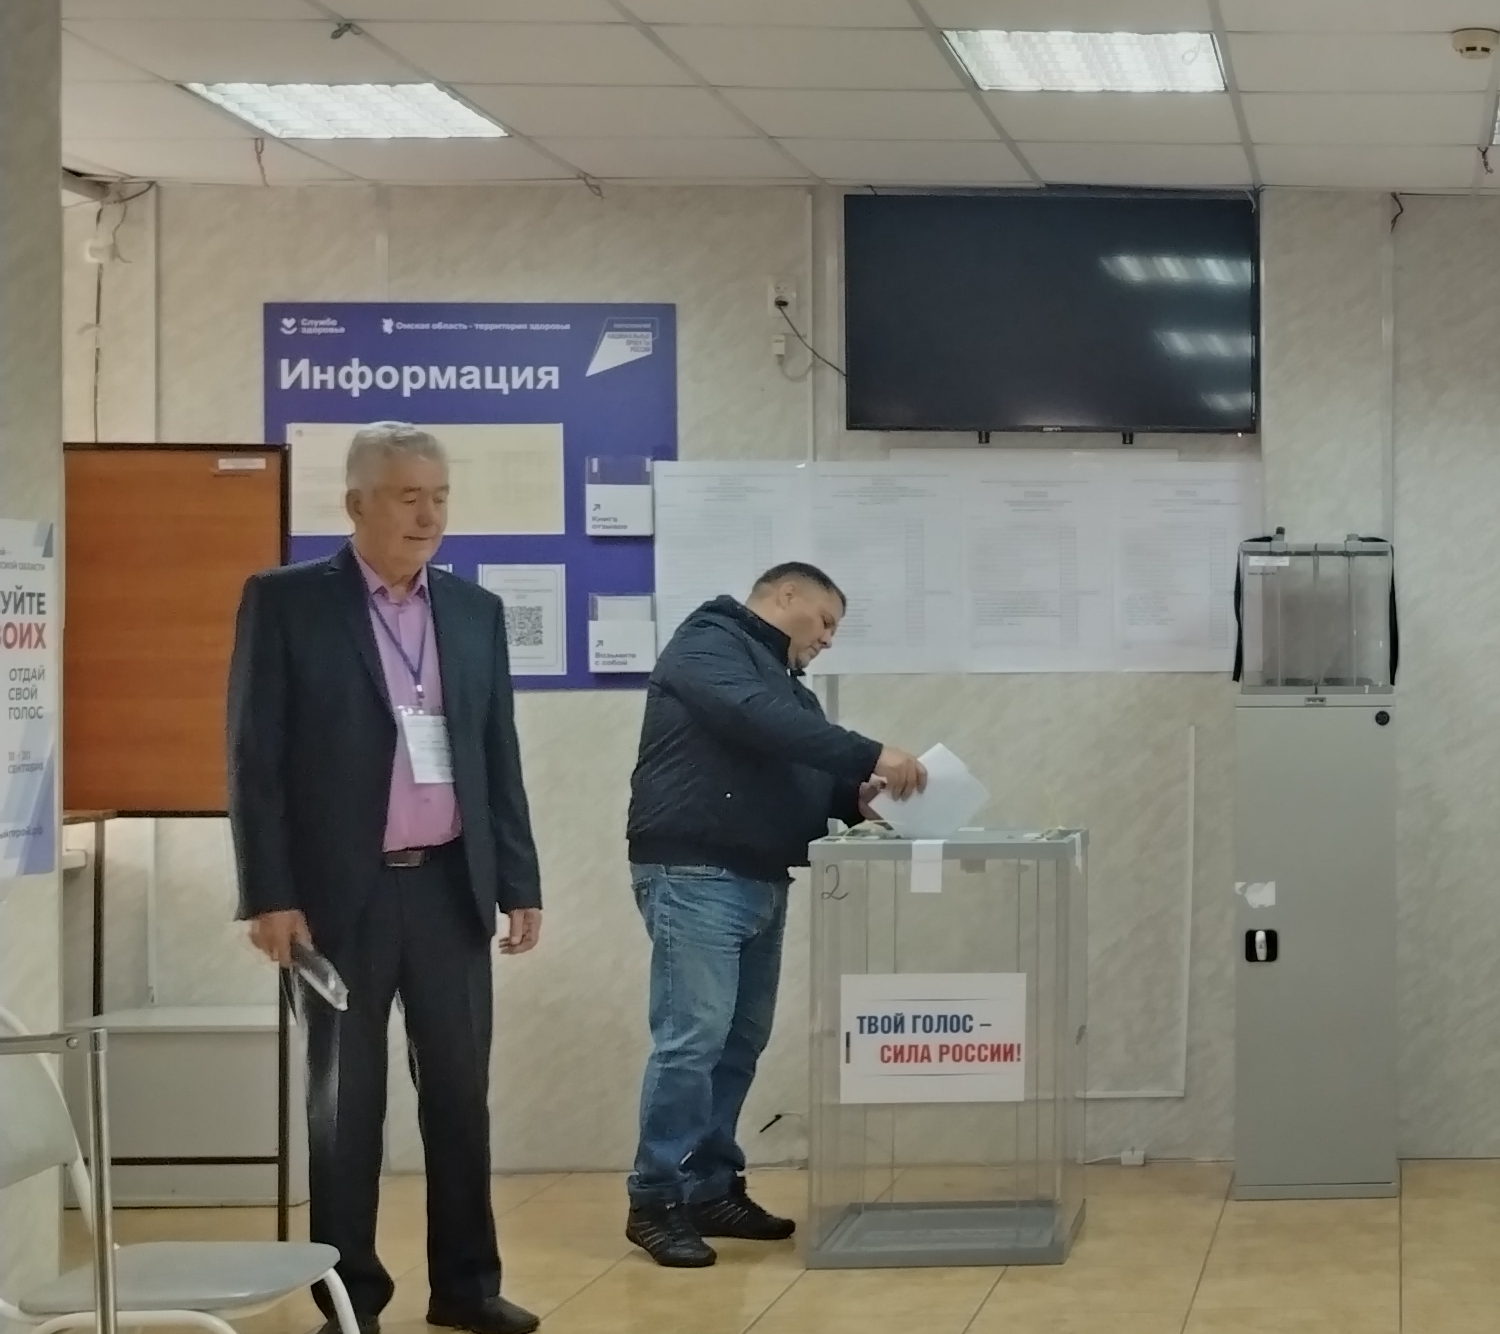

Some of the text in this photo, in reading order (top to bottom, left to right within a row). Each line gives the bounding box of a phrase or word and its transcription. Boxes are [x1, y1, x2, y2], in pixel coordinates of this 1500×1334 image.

[281, 357, 560, 398] Информация
[0, 585, 46, 615] УЙТЕ
[0, 621, 46, 650] ОИХ
[9, 665, 46, 683] ОТДАЙ
[8, 684, 38, 701] СВОЙ
[8, 705, 44, 720] ГОЛОС
[821, 864, 849, 901] 2
[856, 1012, 905, 1035] ТВОЙ
[911, 1014, 974, 1034] ГОЛОС
[880, 1043, 1022, 1064] СИЛА РОССИИ!
